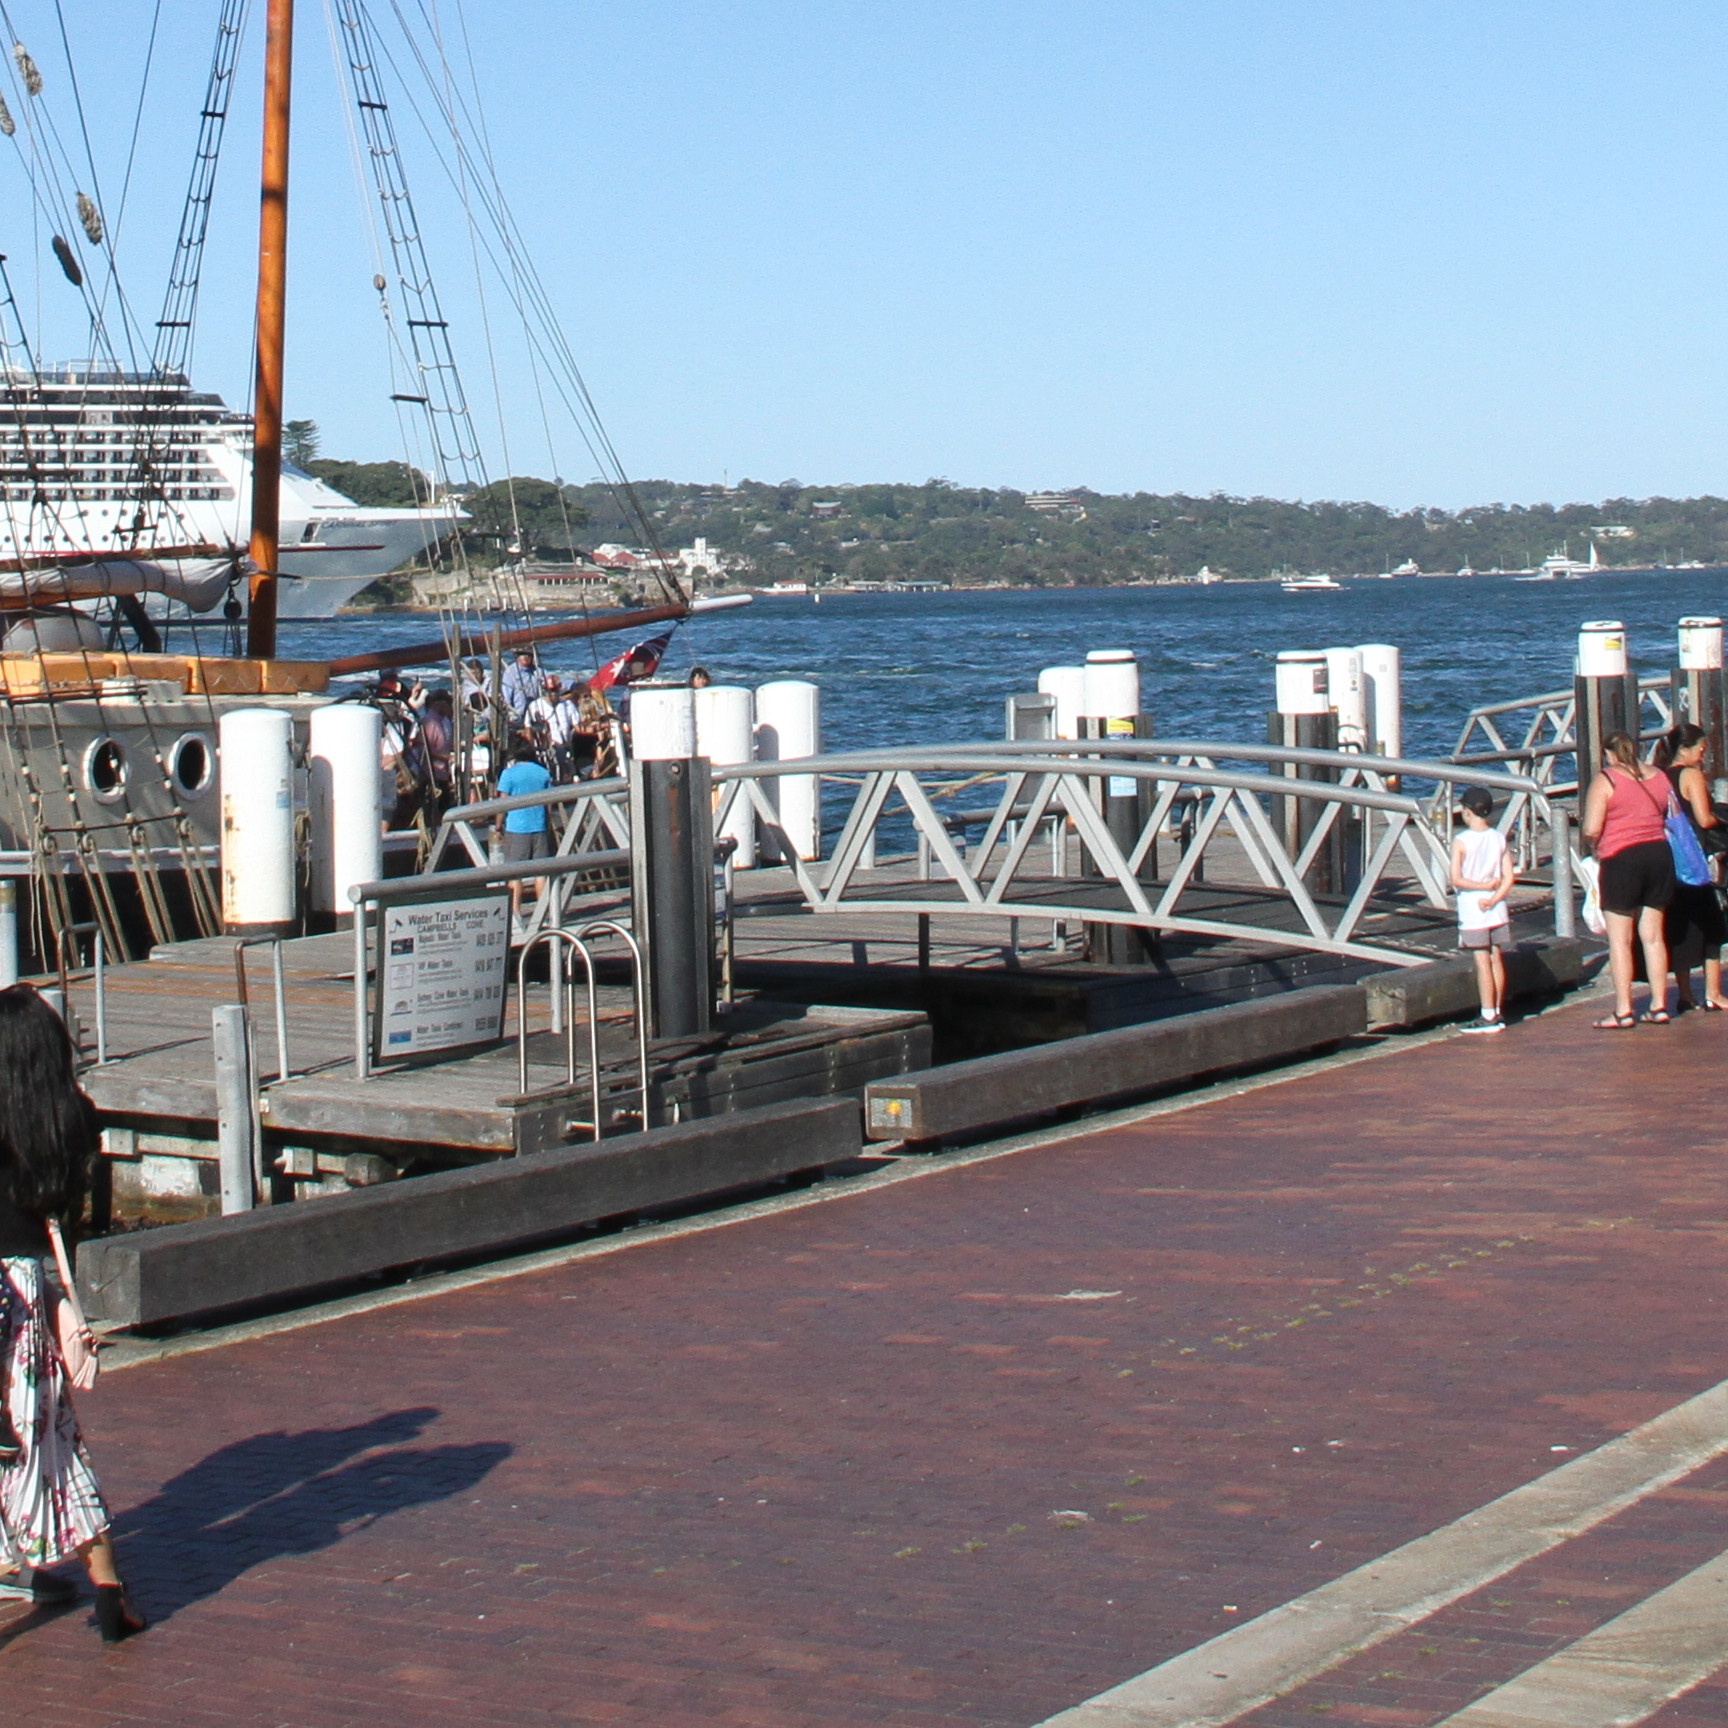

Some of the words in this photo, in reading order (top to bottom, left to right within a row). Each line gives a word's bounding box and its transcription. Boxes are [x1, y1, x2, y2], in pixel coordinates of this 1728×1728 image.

[408, 913, 433, 926] Water
[435, 910, 452, 922] Taxi
[454, 908, 488, 921] Services
[417, 922, 457, 933] CAMPBELLS
